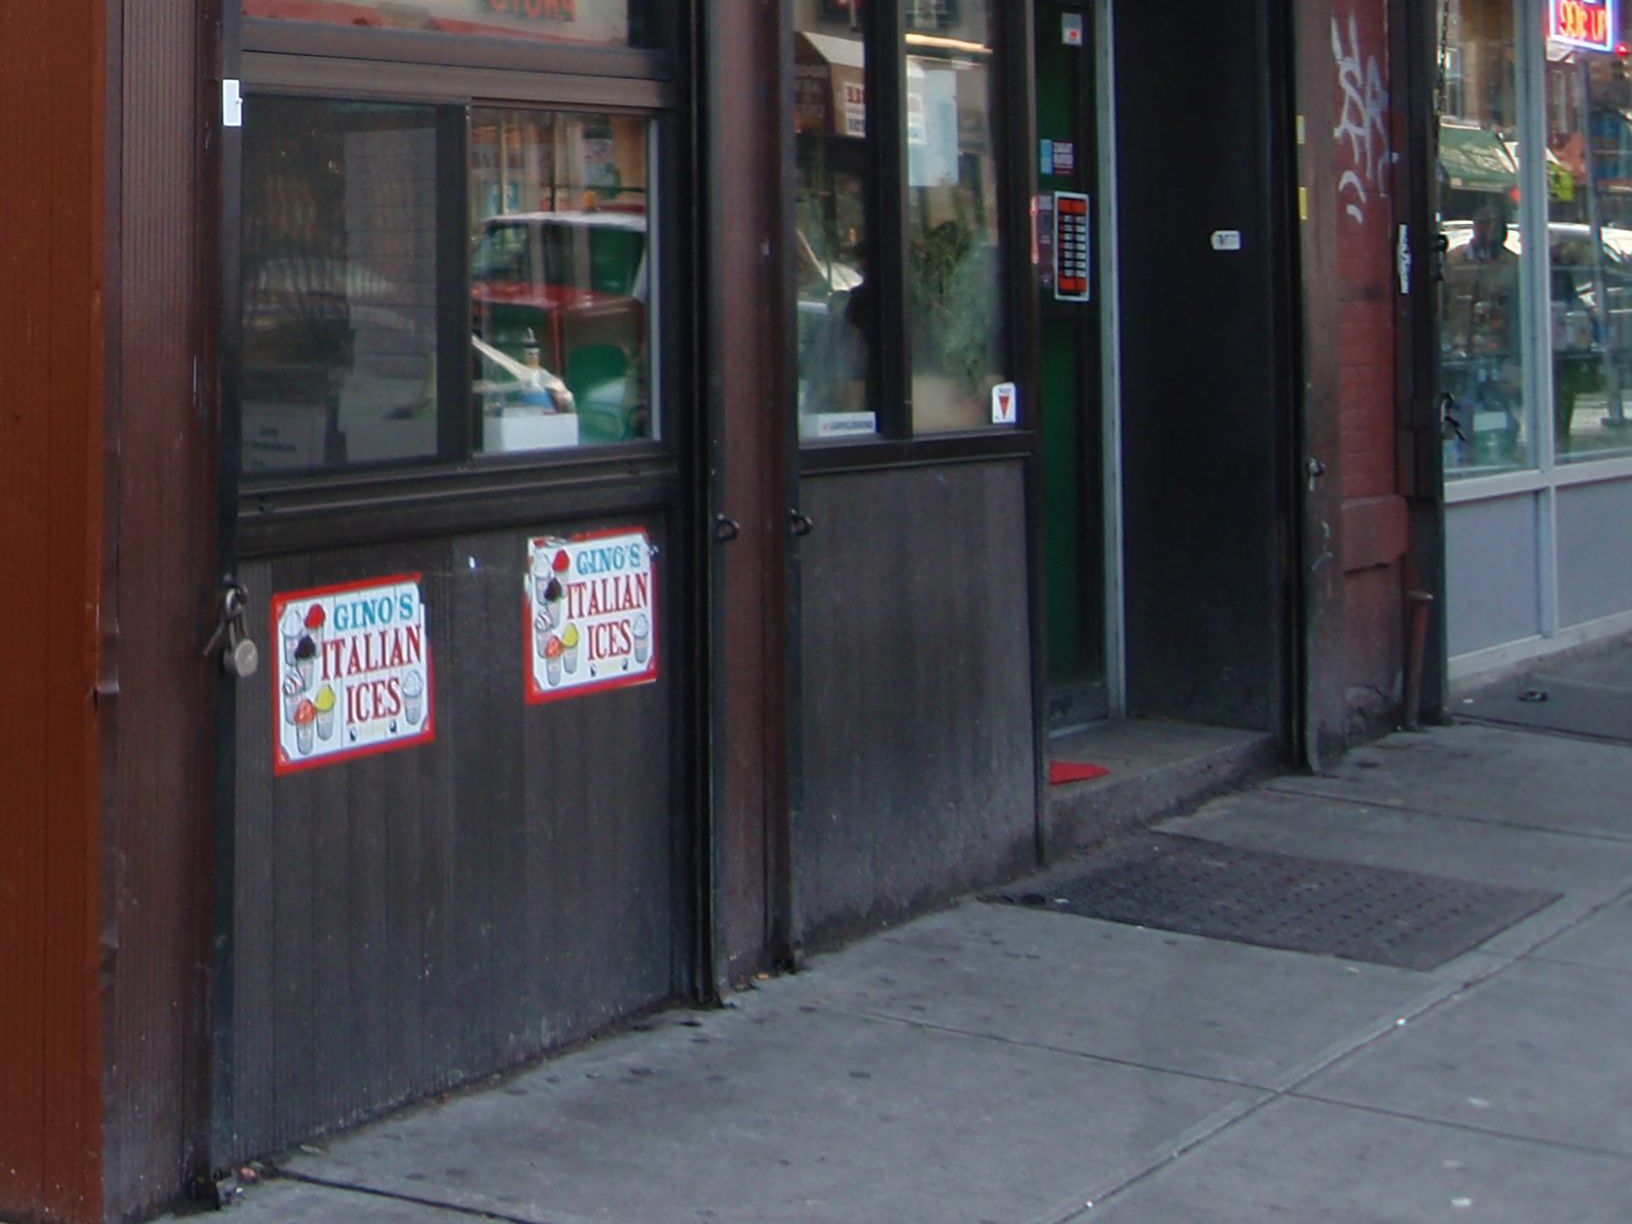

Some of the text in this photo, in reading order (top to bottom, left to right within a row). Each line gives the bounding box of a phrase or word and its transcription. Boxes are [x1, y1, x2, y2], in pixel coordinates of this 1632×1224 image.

[576, 542, 641, 575] GINO'S
[333, 593, 413, 630] GINO'S
[567, 573, 649, 619] ITALIAN
[321, 625, 423, 680] ITALIAN
[587, 620, 632, 661] ICES
[346, 678, 401, 725] ICES
